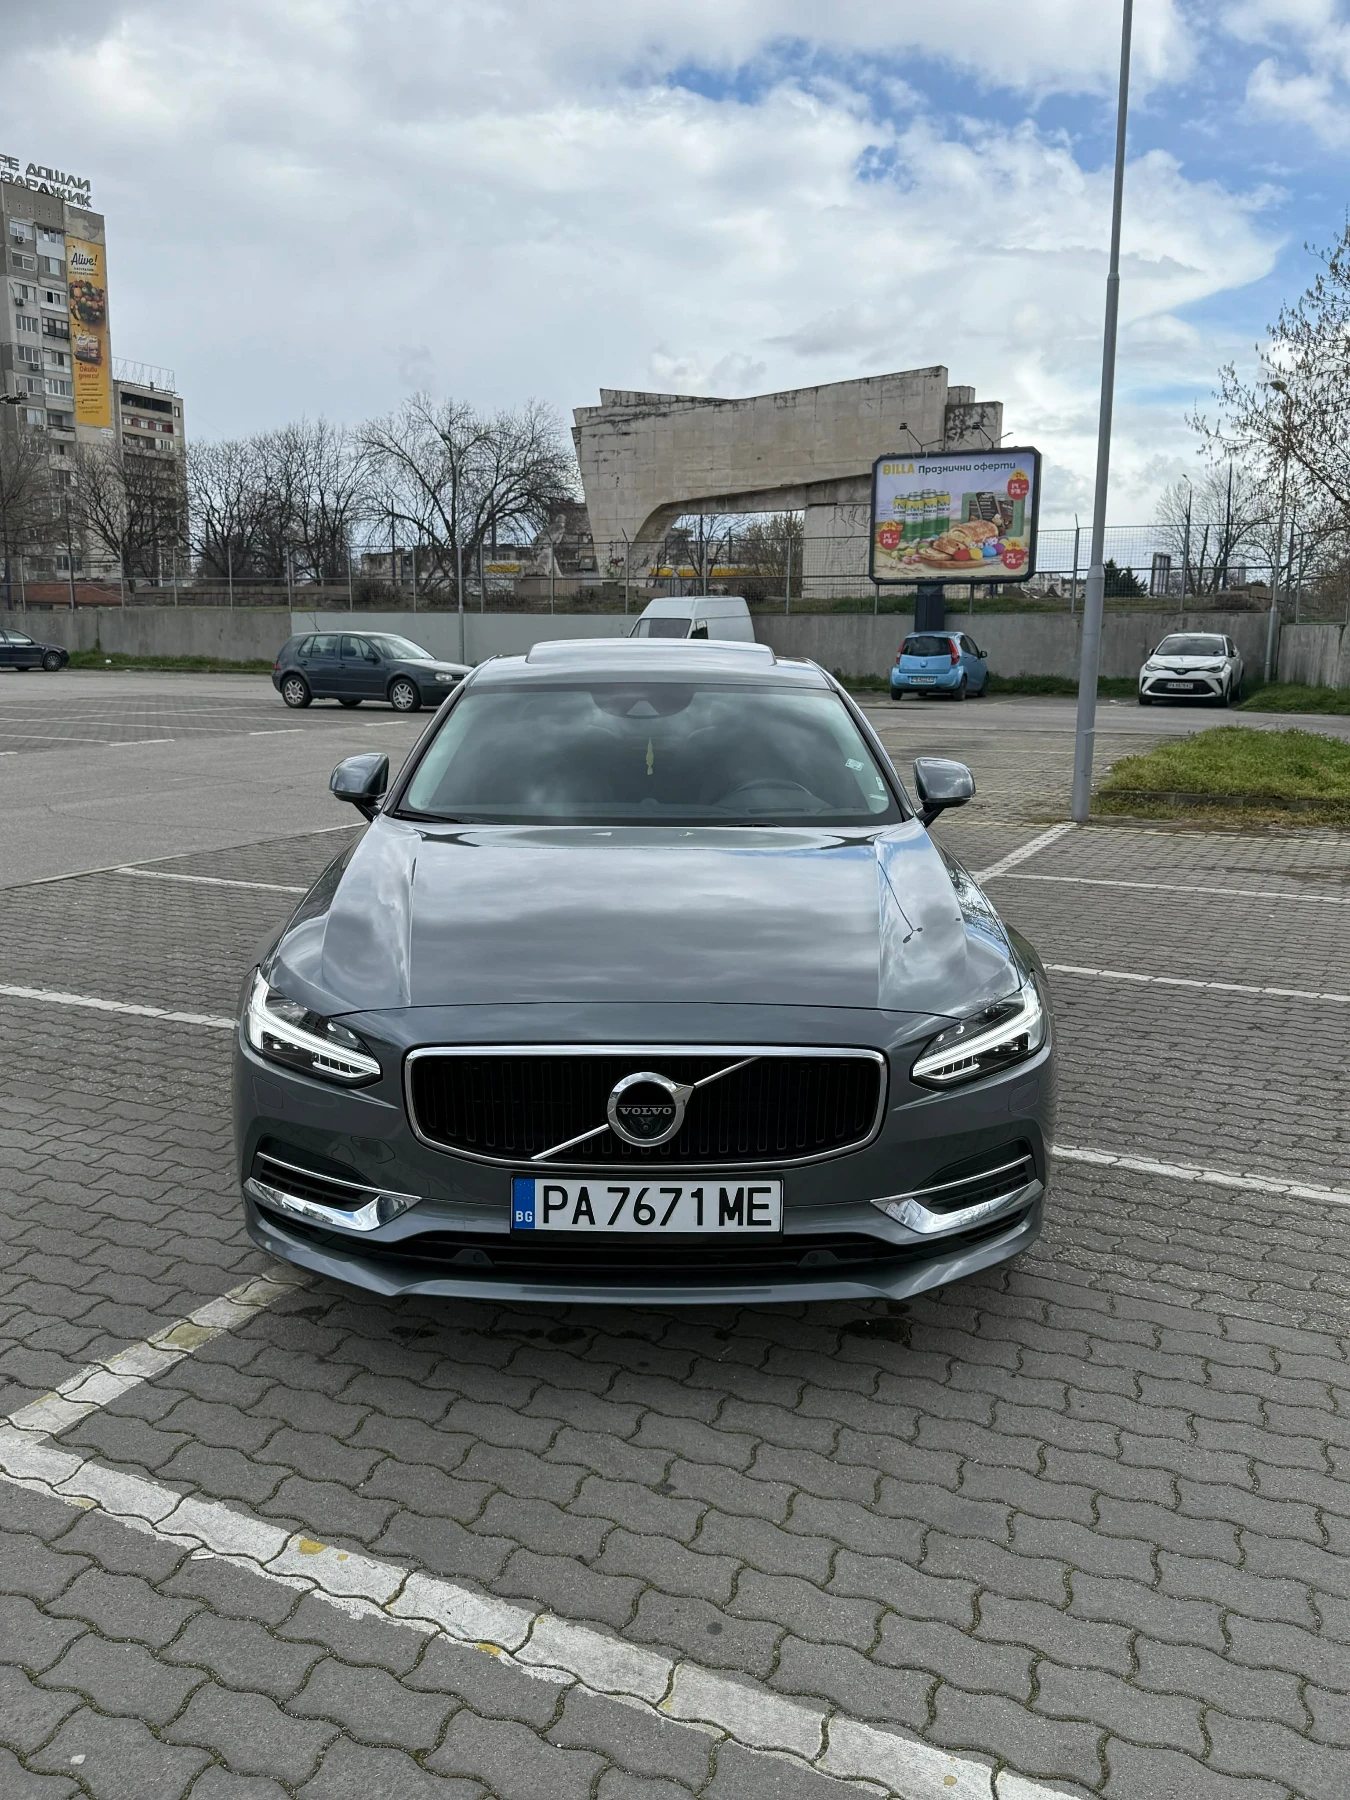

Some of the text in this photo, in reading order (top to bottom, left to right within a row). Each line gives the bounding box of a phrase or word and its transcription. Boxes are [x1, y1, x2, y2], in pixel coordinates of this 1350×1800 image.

[26, 163, 91, 192] ДОШЛИ
[71, 252, 98, 266] Alive!
[882, 463, 915, 475] BILLA
[918, 462, 1016, 475] Празнични оферти
[619, 1107, 672, 1115] VOLVO
[515, 1210, 533, 1223] BG
